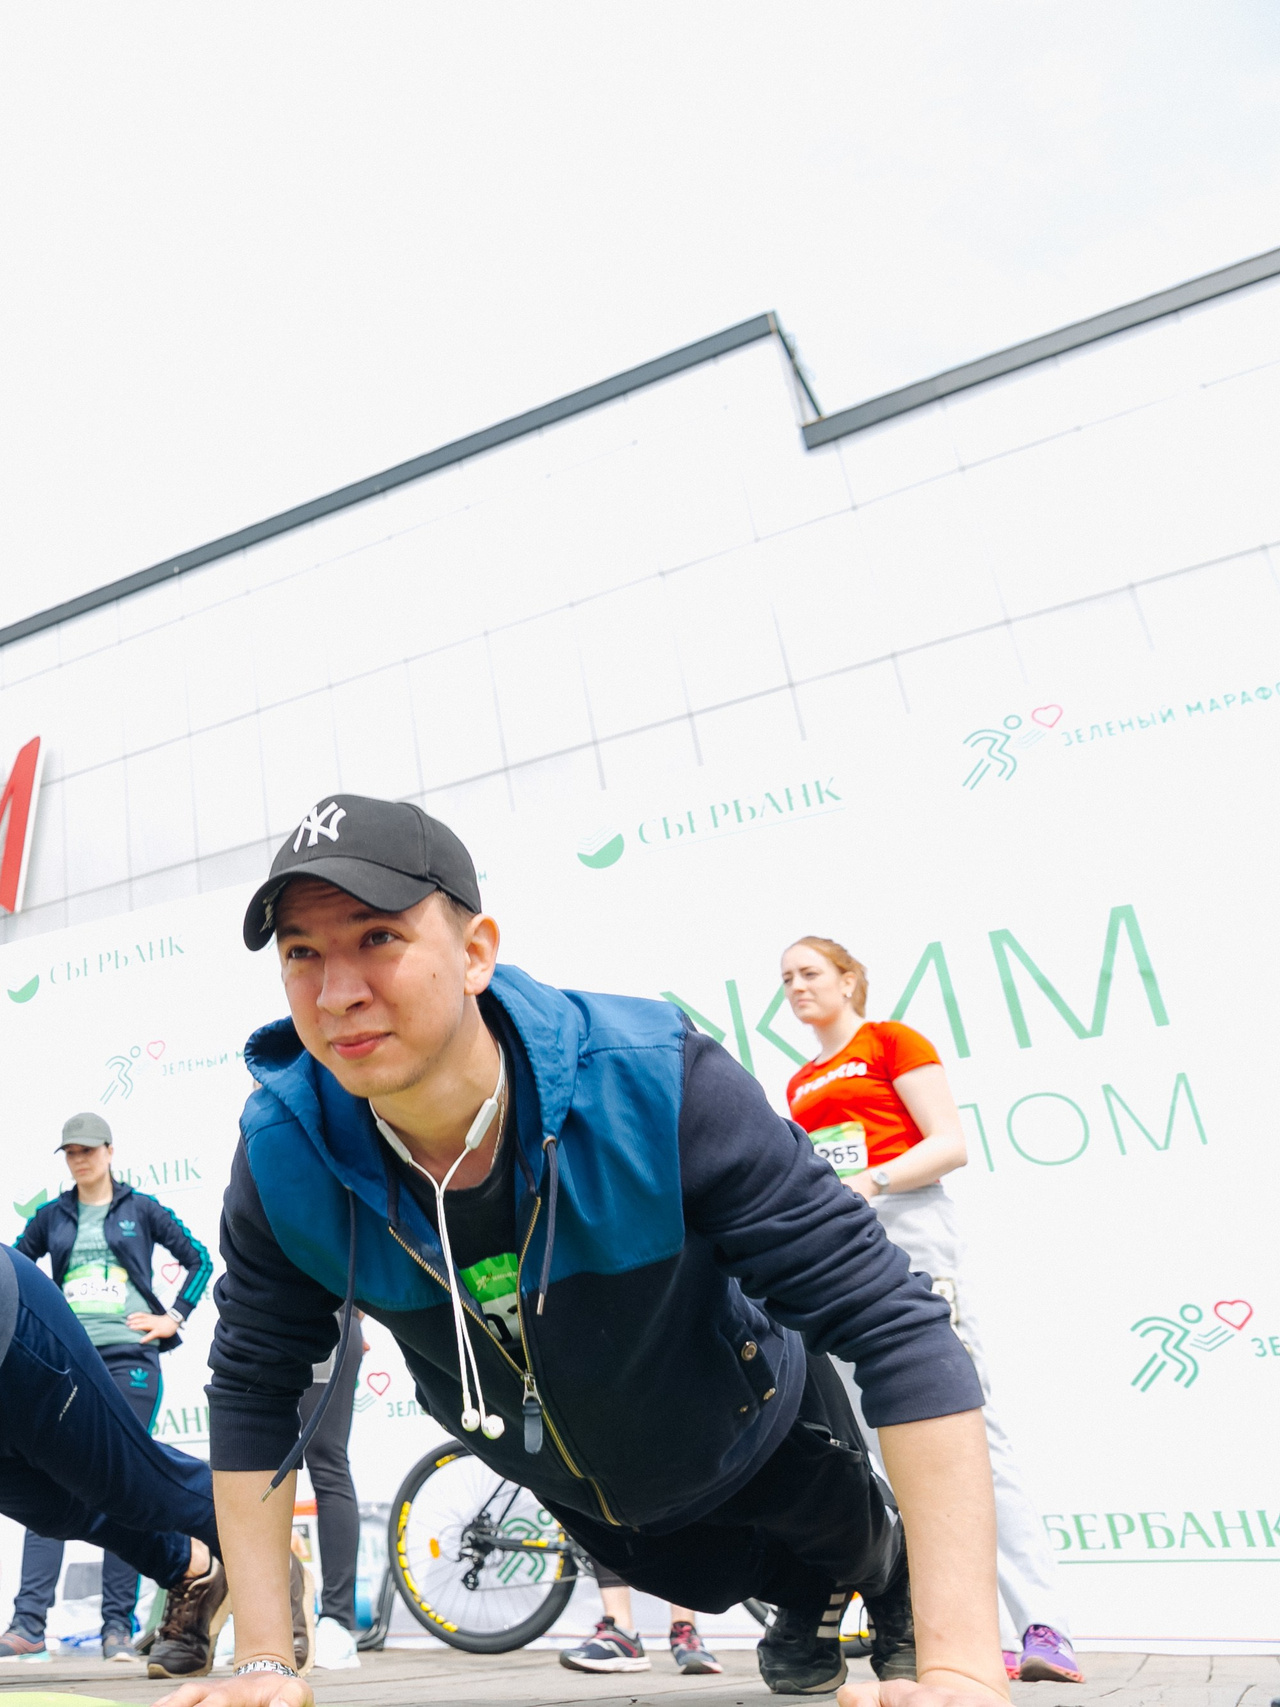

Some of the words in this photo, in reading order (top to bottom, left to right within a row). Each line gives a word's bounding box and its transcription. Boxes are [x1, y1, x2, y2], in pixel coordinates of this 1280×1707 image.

[1061, 704, 1176, 747] ЗЕЛЕНЫЙ
[638, 776, 843, 845] СБЕРБАНК
[50, 934, 185, 985] СБЕРБАНК
